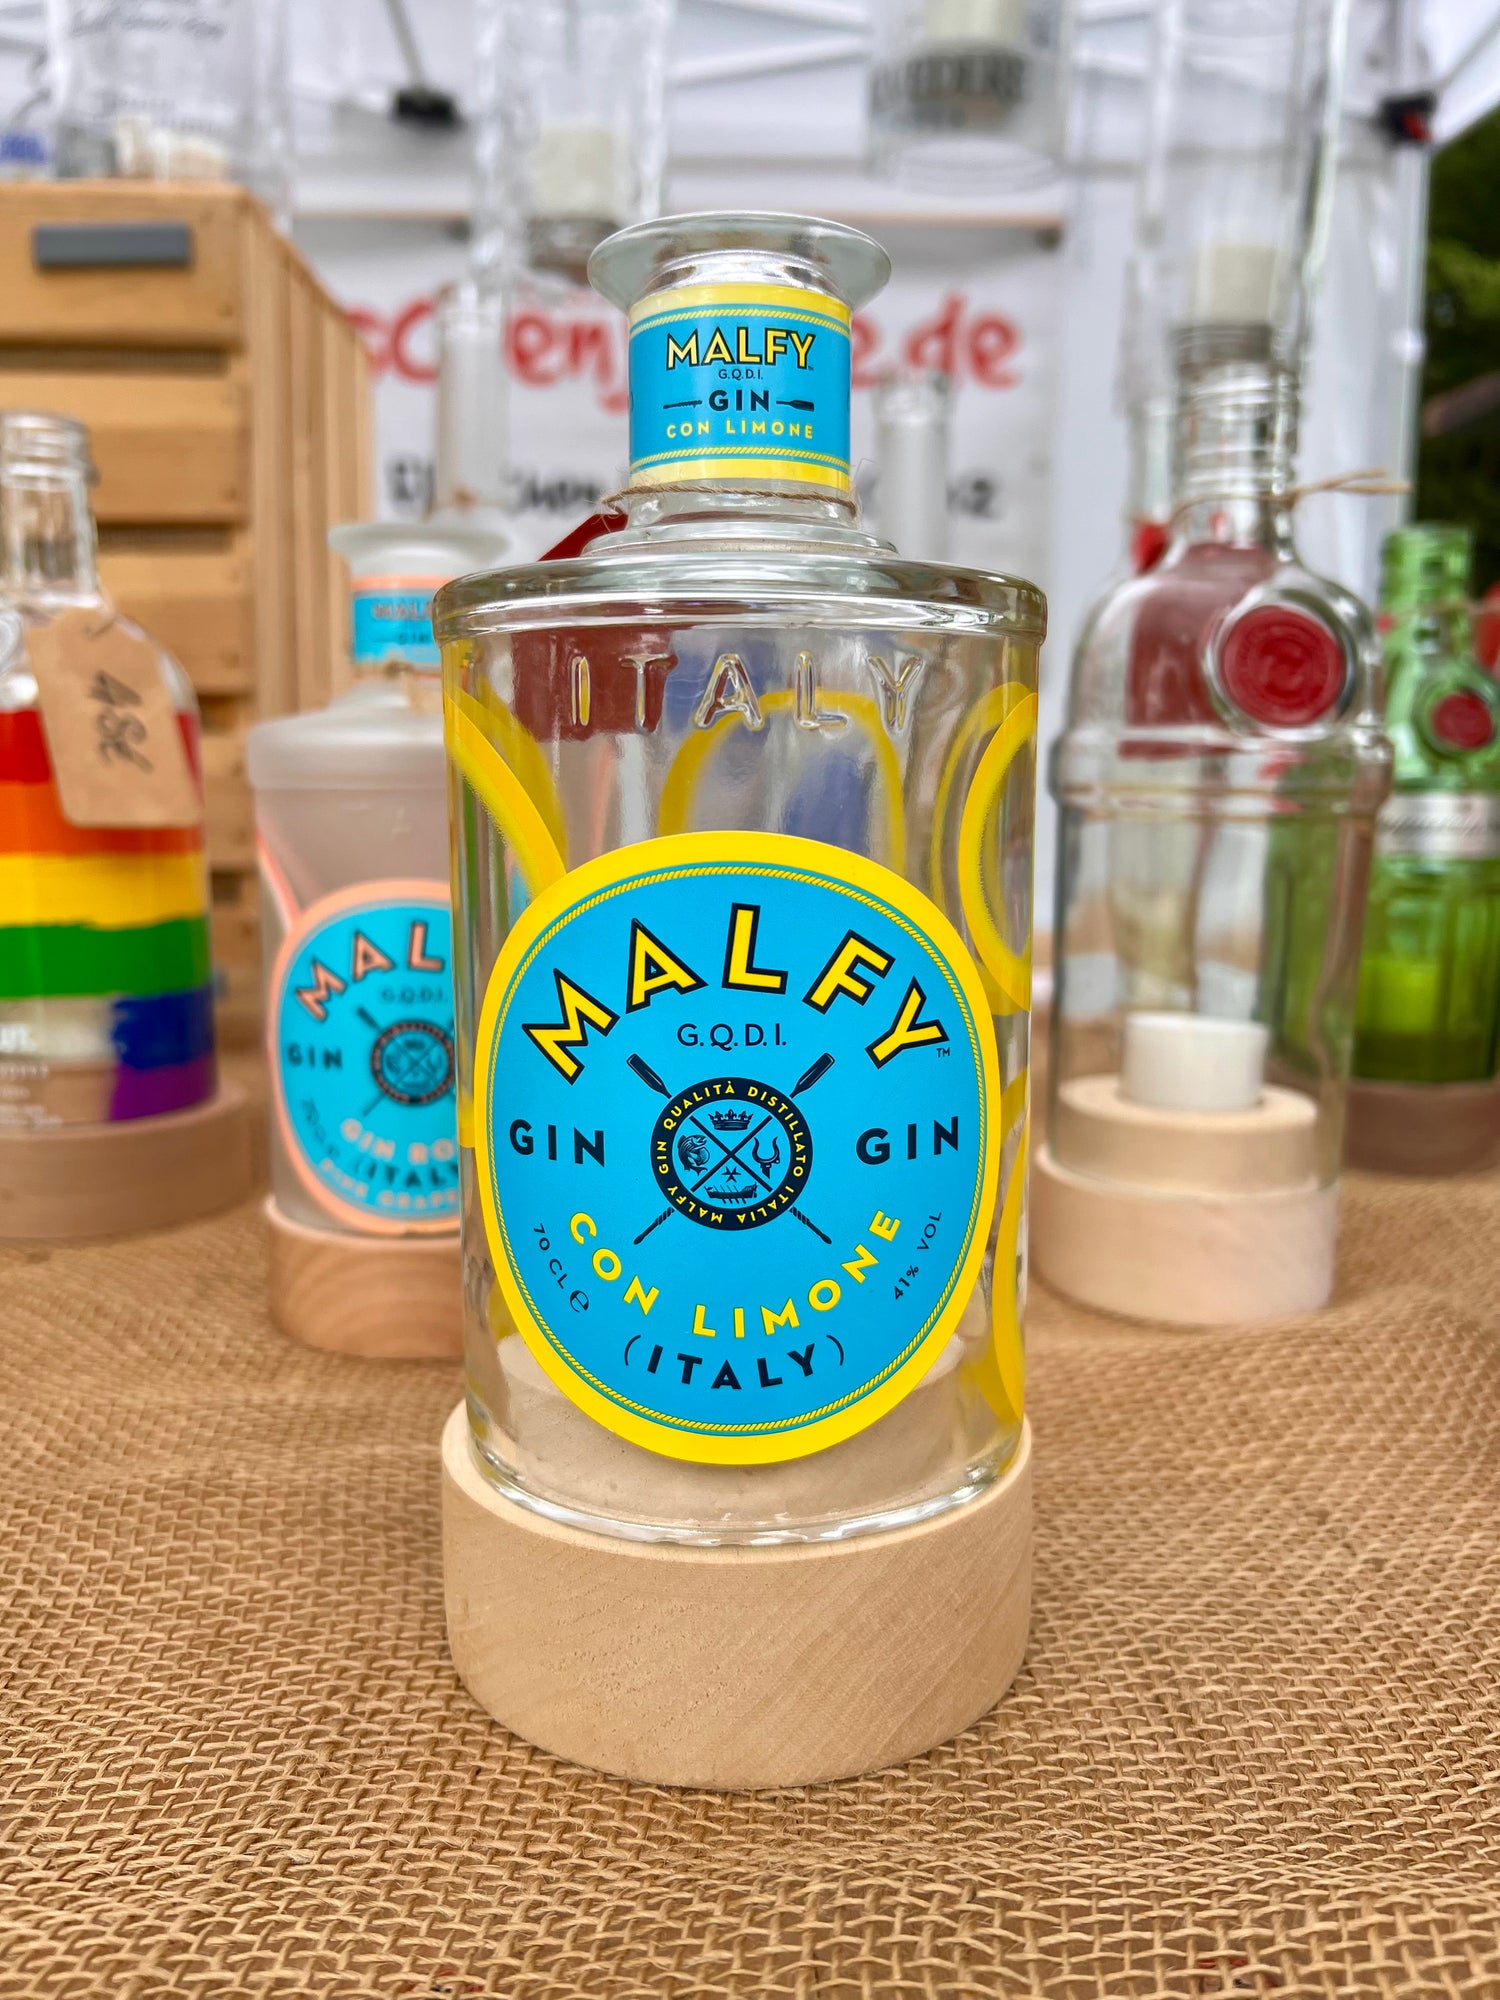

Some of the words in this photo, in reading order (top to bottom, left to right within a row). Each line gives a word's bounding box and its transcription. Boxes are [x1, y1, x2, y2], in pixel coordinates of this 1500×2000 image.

[666, 326, 816, 370] MALFY
[718, 368, 764, 380] G.Q.D.I.
[708, 389, 770, 412] GIN
[666, 420, 710, 439] CON
[725, 419, 814, 440] LIMONE
[571, 650, 925, 733] ITALY
[522, 902, 950, 1085] MALFY
[288, 1042, 342, 1070] GIN
[677, 1022, 787, 1051] G.Q.D.I.
[663, 1081, 735, 1130] QUALITÀ
[341, 1118, 396, 1161] GIN
[510, 1119, 605, 1168] GIN
[747, 1086, 806, 1177] DISTILLATO
[856, 1116, 958, 1166] GIN
[656, 1140, 670, 1174] GIN
[667, 1185, 723, 1224] MALFY
[736, 1185, 795, 1224] ITALIA
[533, 1223, 550, 1251] 70
[550, 1258, 568, 1289] CL
[569, 1211, 660, 1316] CON
[692, 1209, 902, 1338] LIMONE
[893, 1265, 919, 1301] 41%
[916, 1211, 942, 1250] VOL
[624, 1334, 844, 1390] (ITALY)
